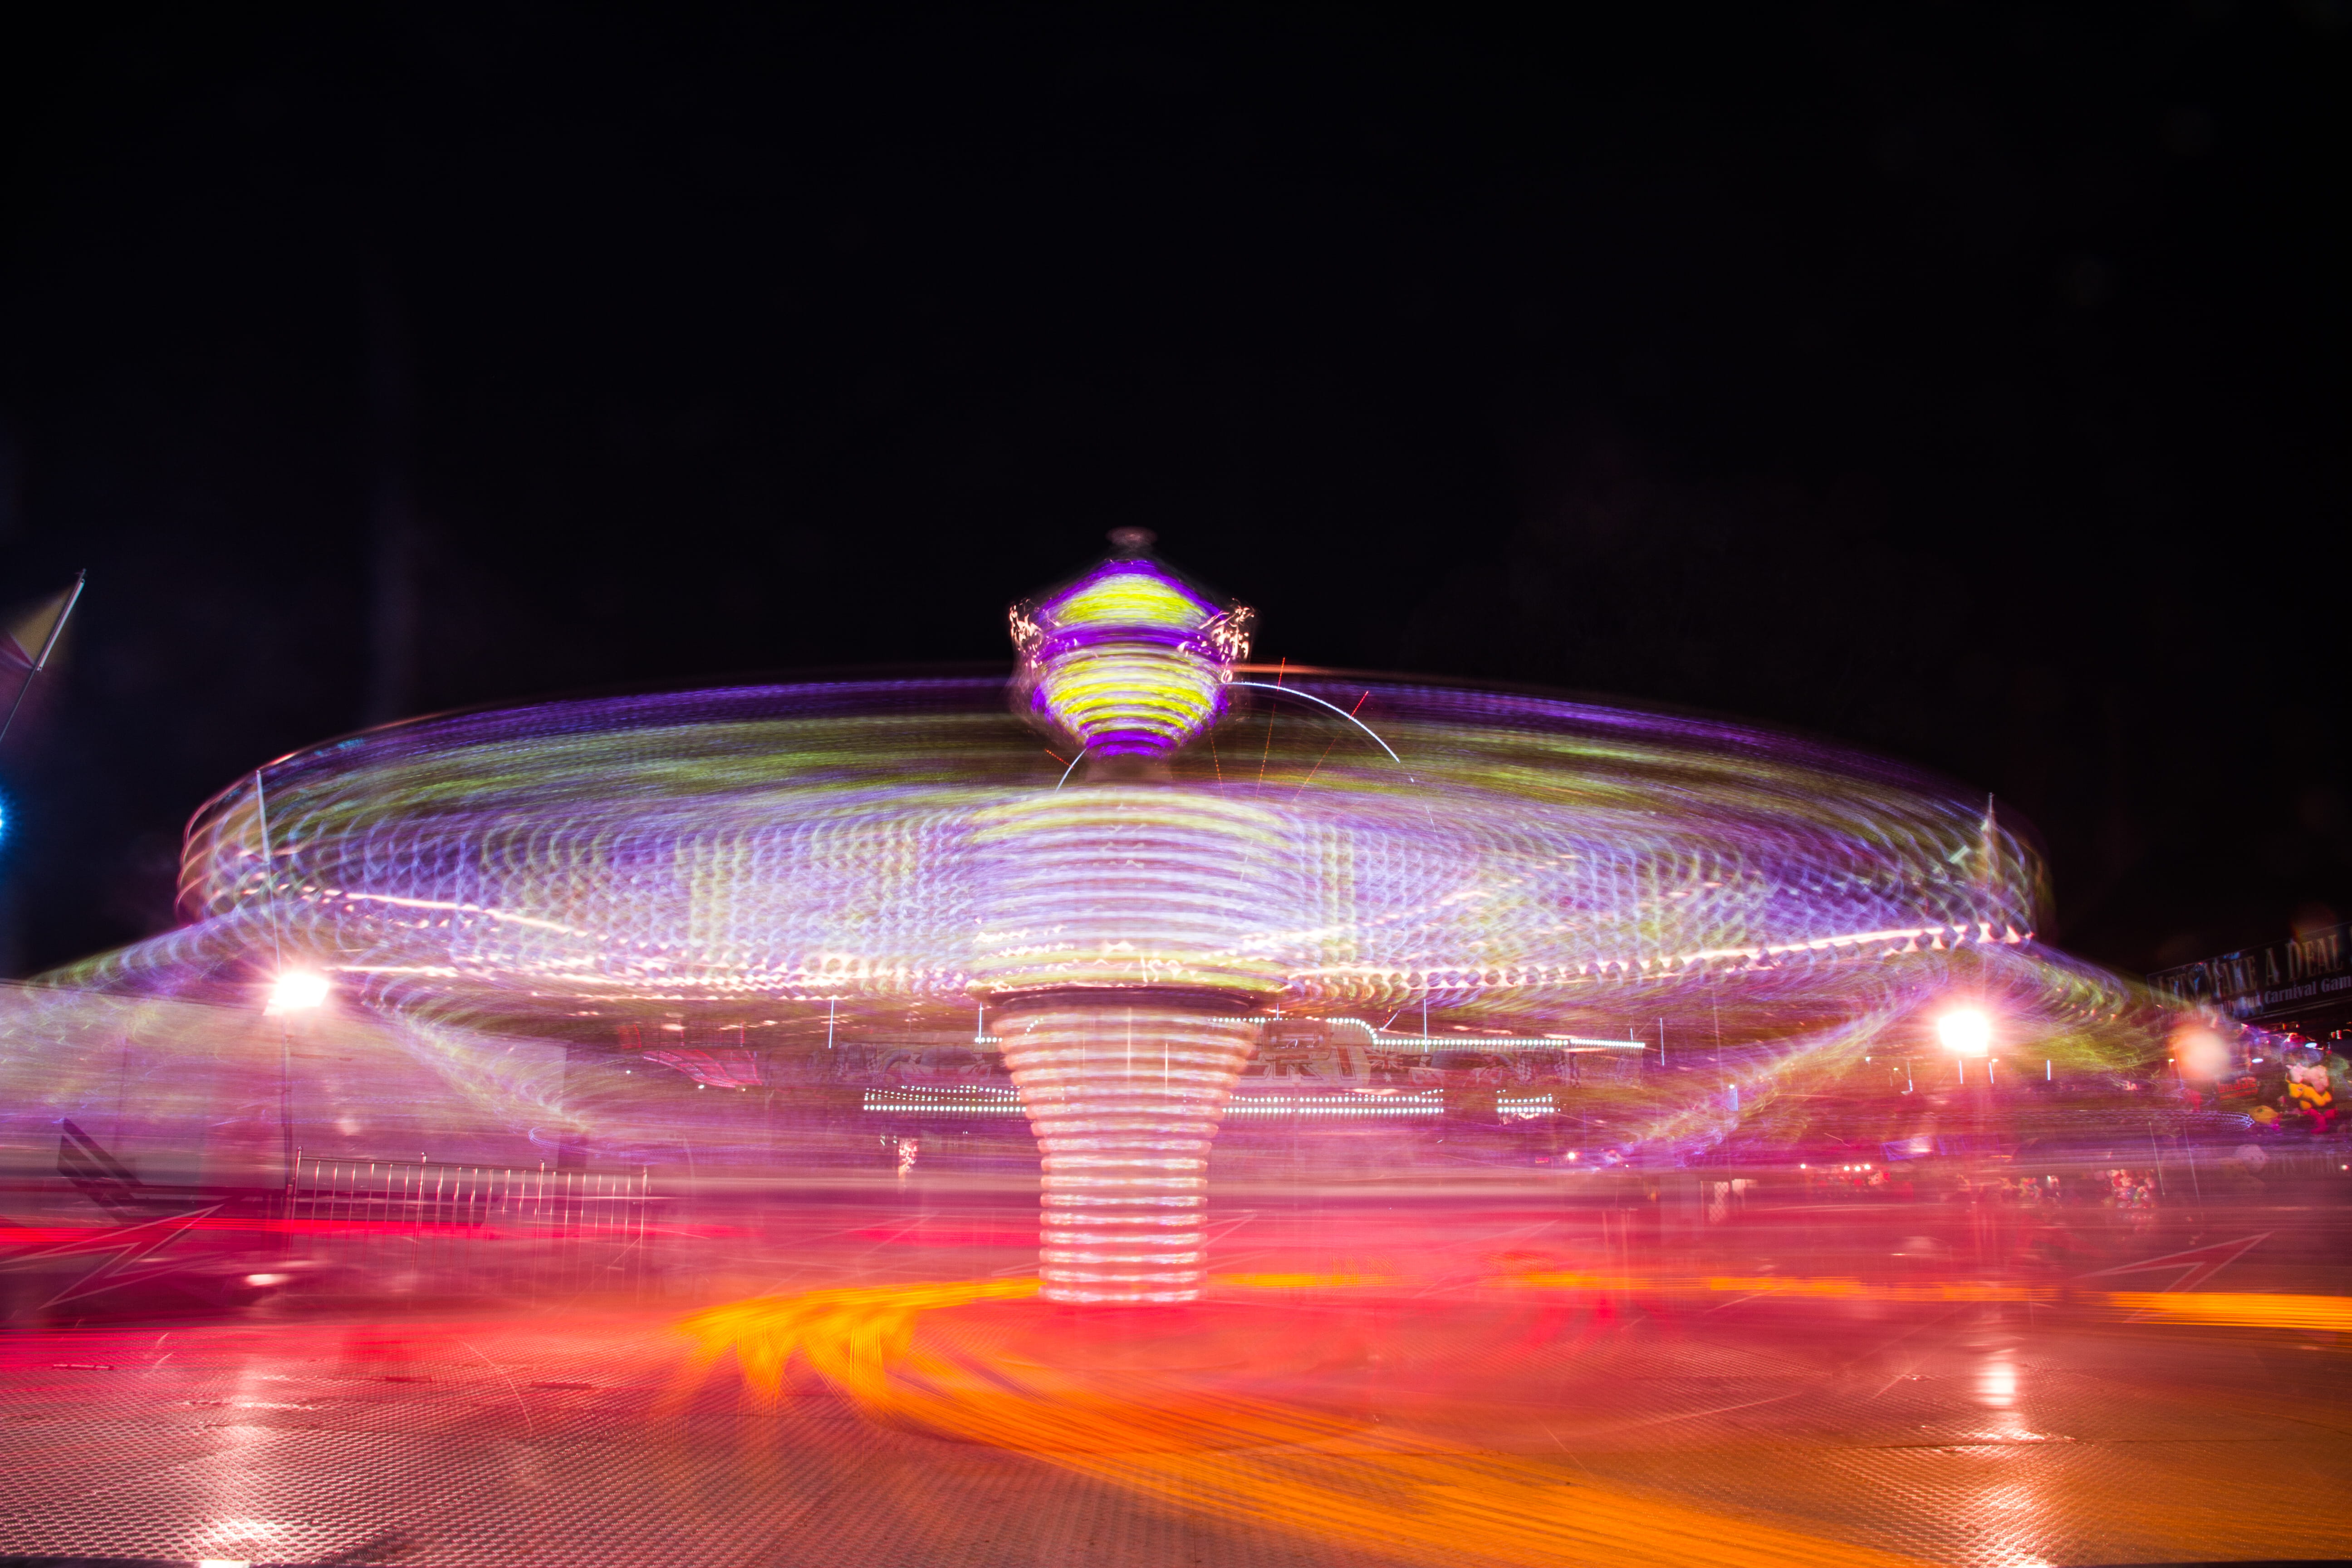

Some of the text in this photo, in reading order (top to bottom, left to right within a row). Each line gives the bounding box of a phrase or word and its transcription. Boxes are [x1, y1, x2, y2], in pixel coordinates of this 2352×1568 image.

[2204, 955, 2258, 998] MAKE
[2265, 947, 2280, 986] A
[2285, 934, 2344, 982] DEAL
[2264, 981, 2316, 1004] Carnival
